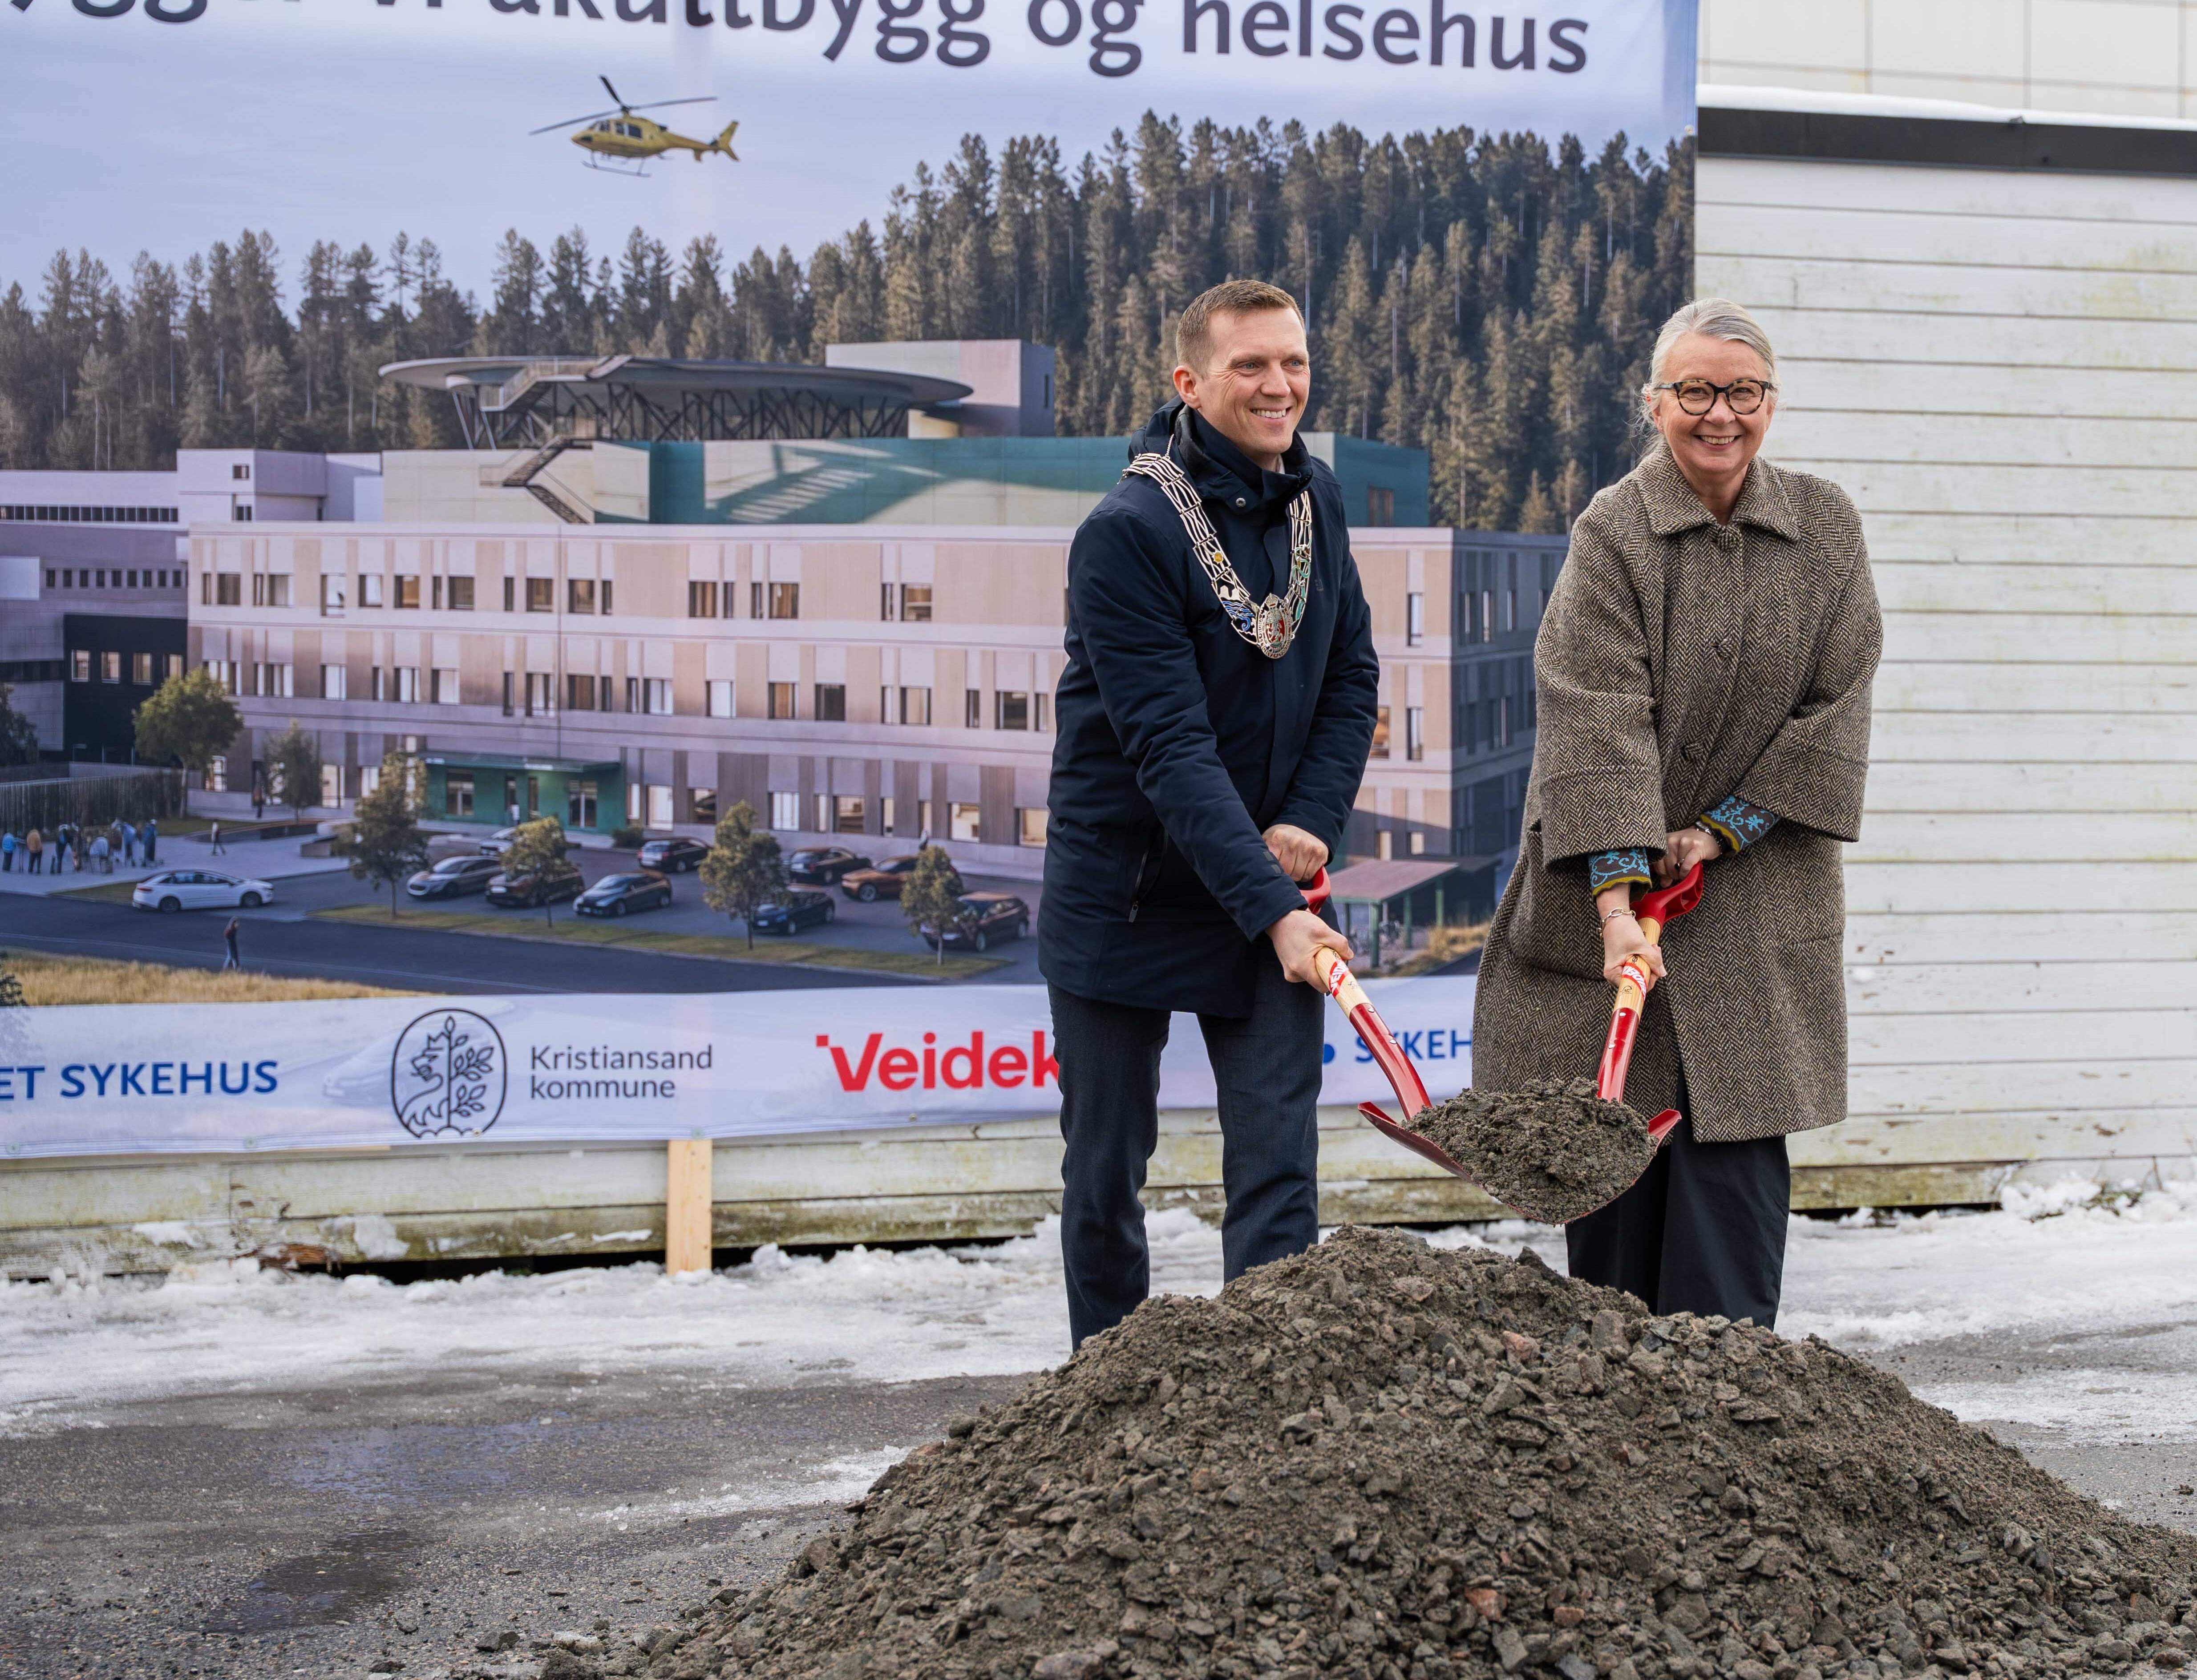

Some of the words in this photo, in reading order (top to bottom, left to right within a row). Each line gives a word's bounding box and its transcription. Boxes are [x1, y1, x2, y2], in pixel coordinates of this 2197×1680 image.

[1027, 0, 1145, 78] og
[531, 1044, 712, 1070] Kristiansand
[816, 1030, 1060, 1091] Veidek
[60, 1060, 279, 1099] SYKEHUS
[531, 1074, 676, 1099] kommune
